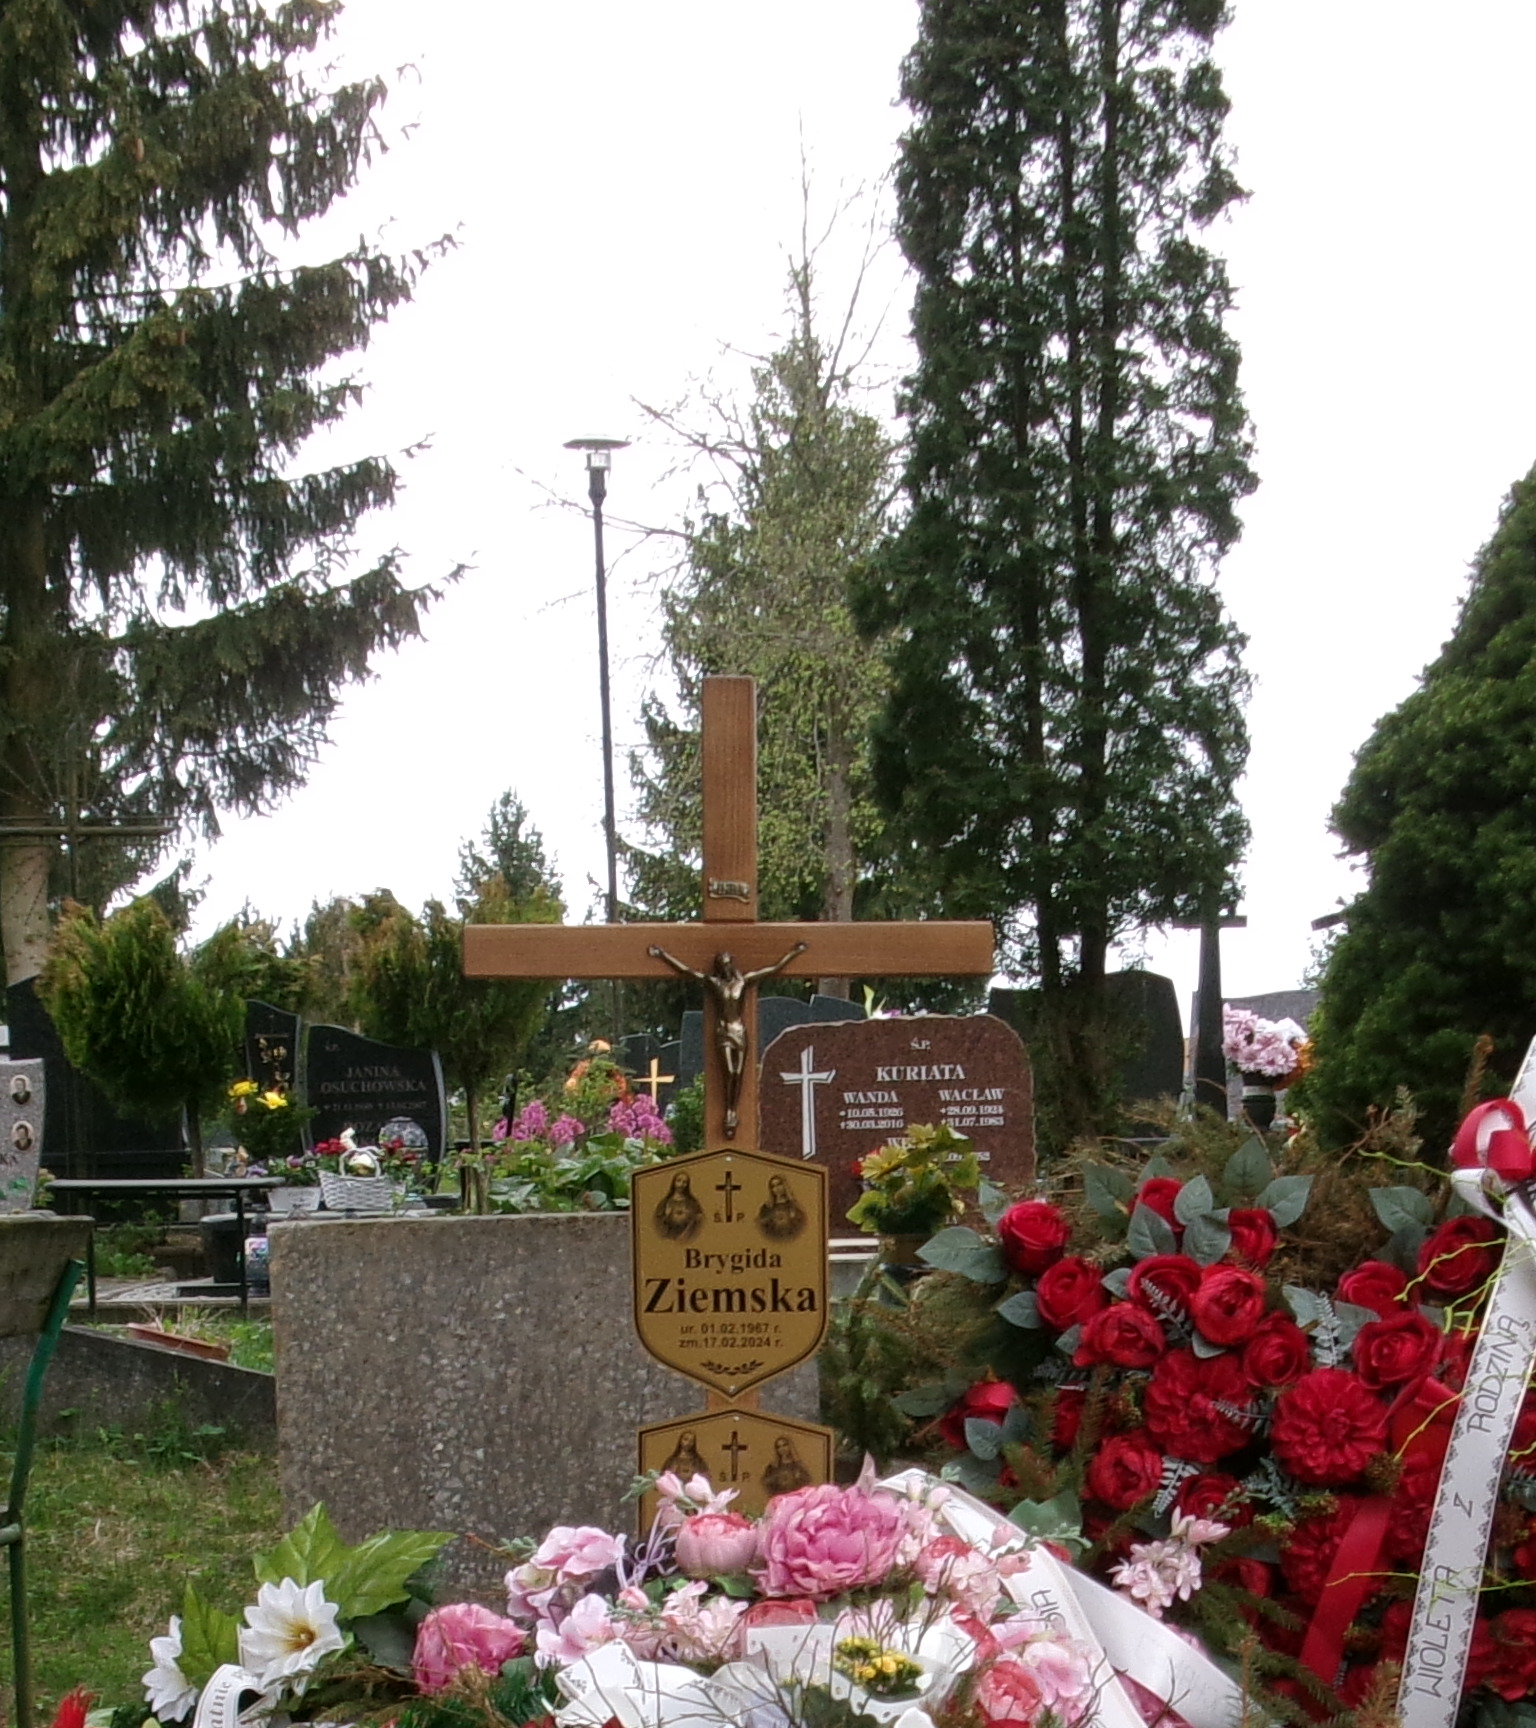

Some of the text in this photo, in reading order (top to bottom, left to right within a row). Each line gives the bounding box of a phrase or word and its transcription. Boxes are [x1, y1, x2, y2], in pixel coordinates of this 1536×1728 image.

[347, 1066, 401, 1079] JANINA
[876, 1064, 966, 1081] KURIATA
[320, 1080, 426, 1094] OSUCHOWSKA
[843, 1090, 899, 1104] WANDA
[938, 1088, 1005, 1101] WACŁAW
[685, 1248, 782, 1274] Brygida
[644, 1277, 818, 1314] Ziemska
